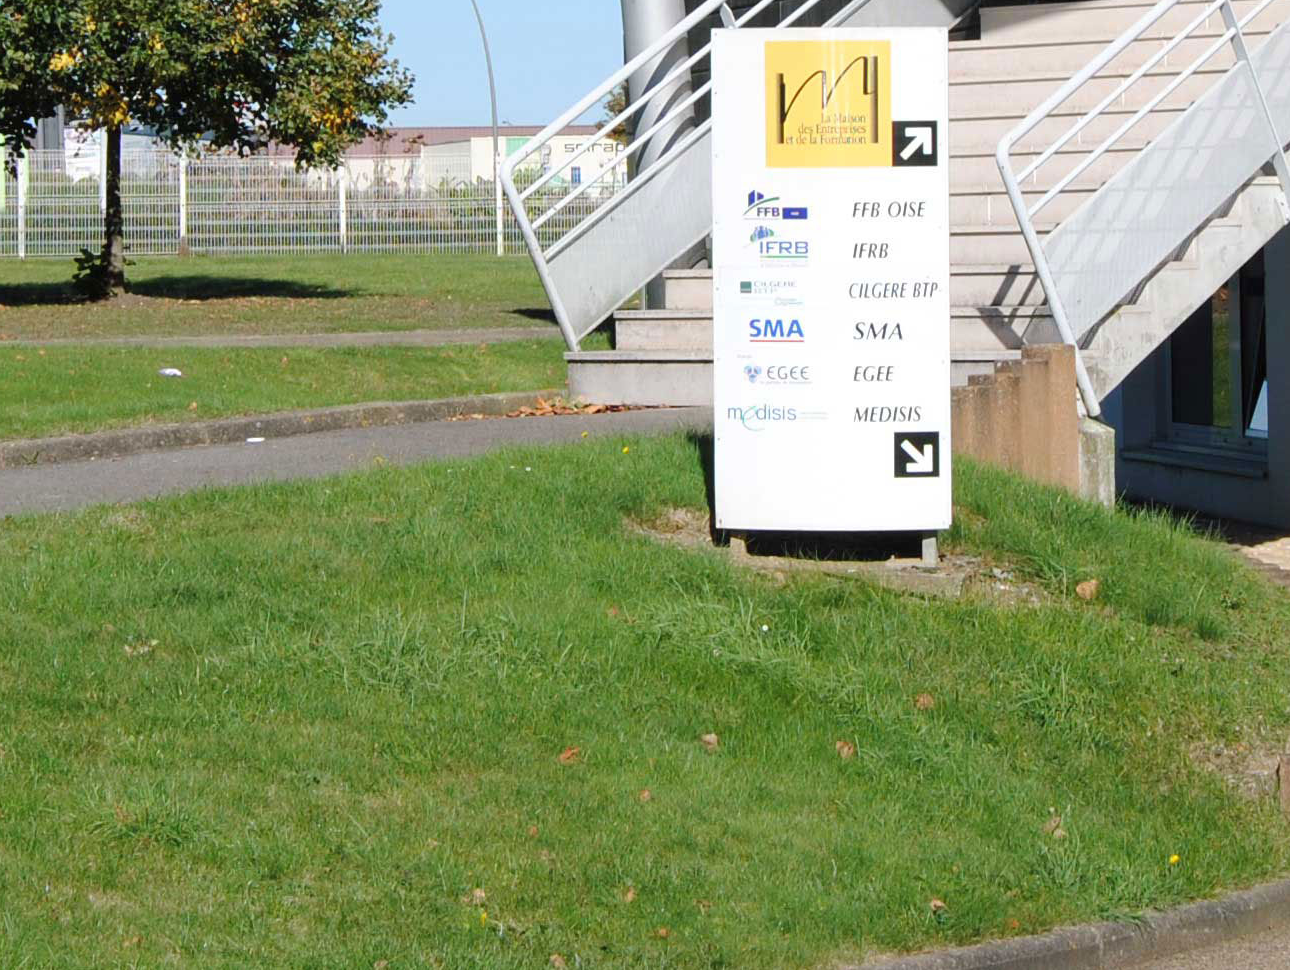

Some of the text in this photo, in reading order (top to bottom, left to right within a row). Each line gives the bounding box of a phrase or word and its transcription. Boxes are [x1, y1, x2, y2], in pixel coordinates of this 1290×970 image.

[756, 207, 780, 217] FFB
[852, 200, 926, 218] FFB OISE
[759, 241, 809, 255] IFRB
[852, 242, 889, 259] IFRB
[848, 281, 939, 299] CILGERE BTP
[749, 319, 804, 338] SMA
[853, 321, 903, 340] SMA
[767, 365, 810, 380] EGEE
[853, 365, 894, 382] EGEE
[853, 405, 922, 423] MEDISIS
